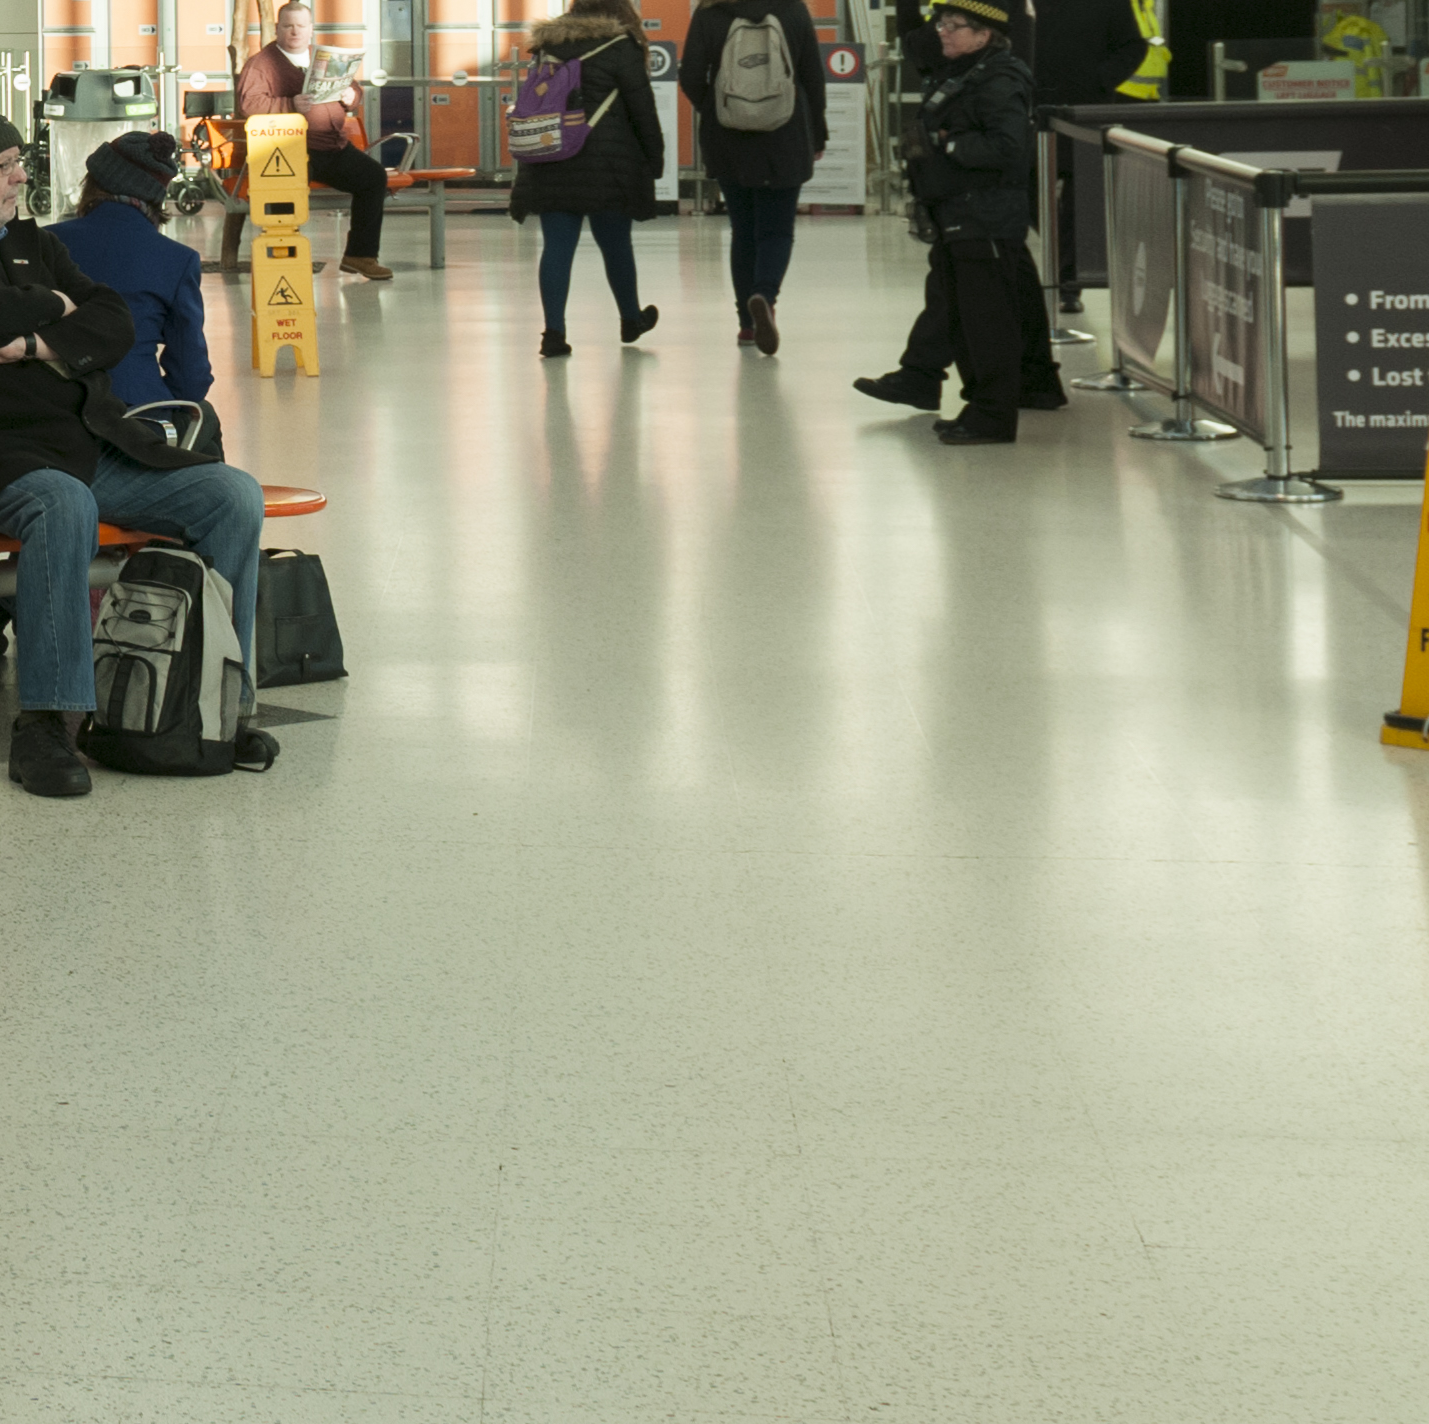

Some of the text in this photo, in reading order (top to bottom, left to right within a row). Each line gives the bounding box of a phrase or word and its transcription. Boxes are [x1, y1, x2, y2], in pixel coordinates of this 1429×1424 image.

[250, 128, 304, 137] CAUTION
[1370, 290, 1429, 310] From
[276, 318, 297, 327] WET
[272, 331, 303, 341] FLOOR
[1372, 367, 1423, 387] Lost
[1333, 410, 1366, 427] The
